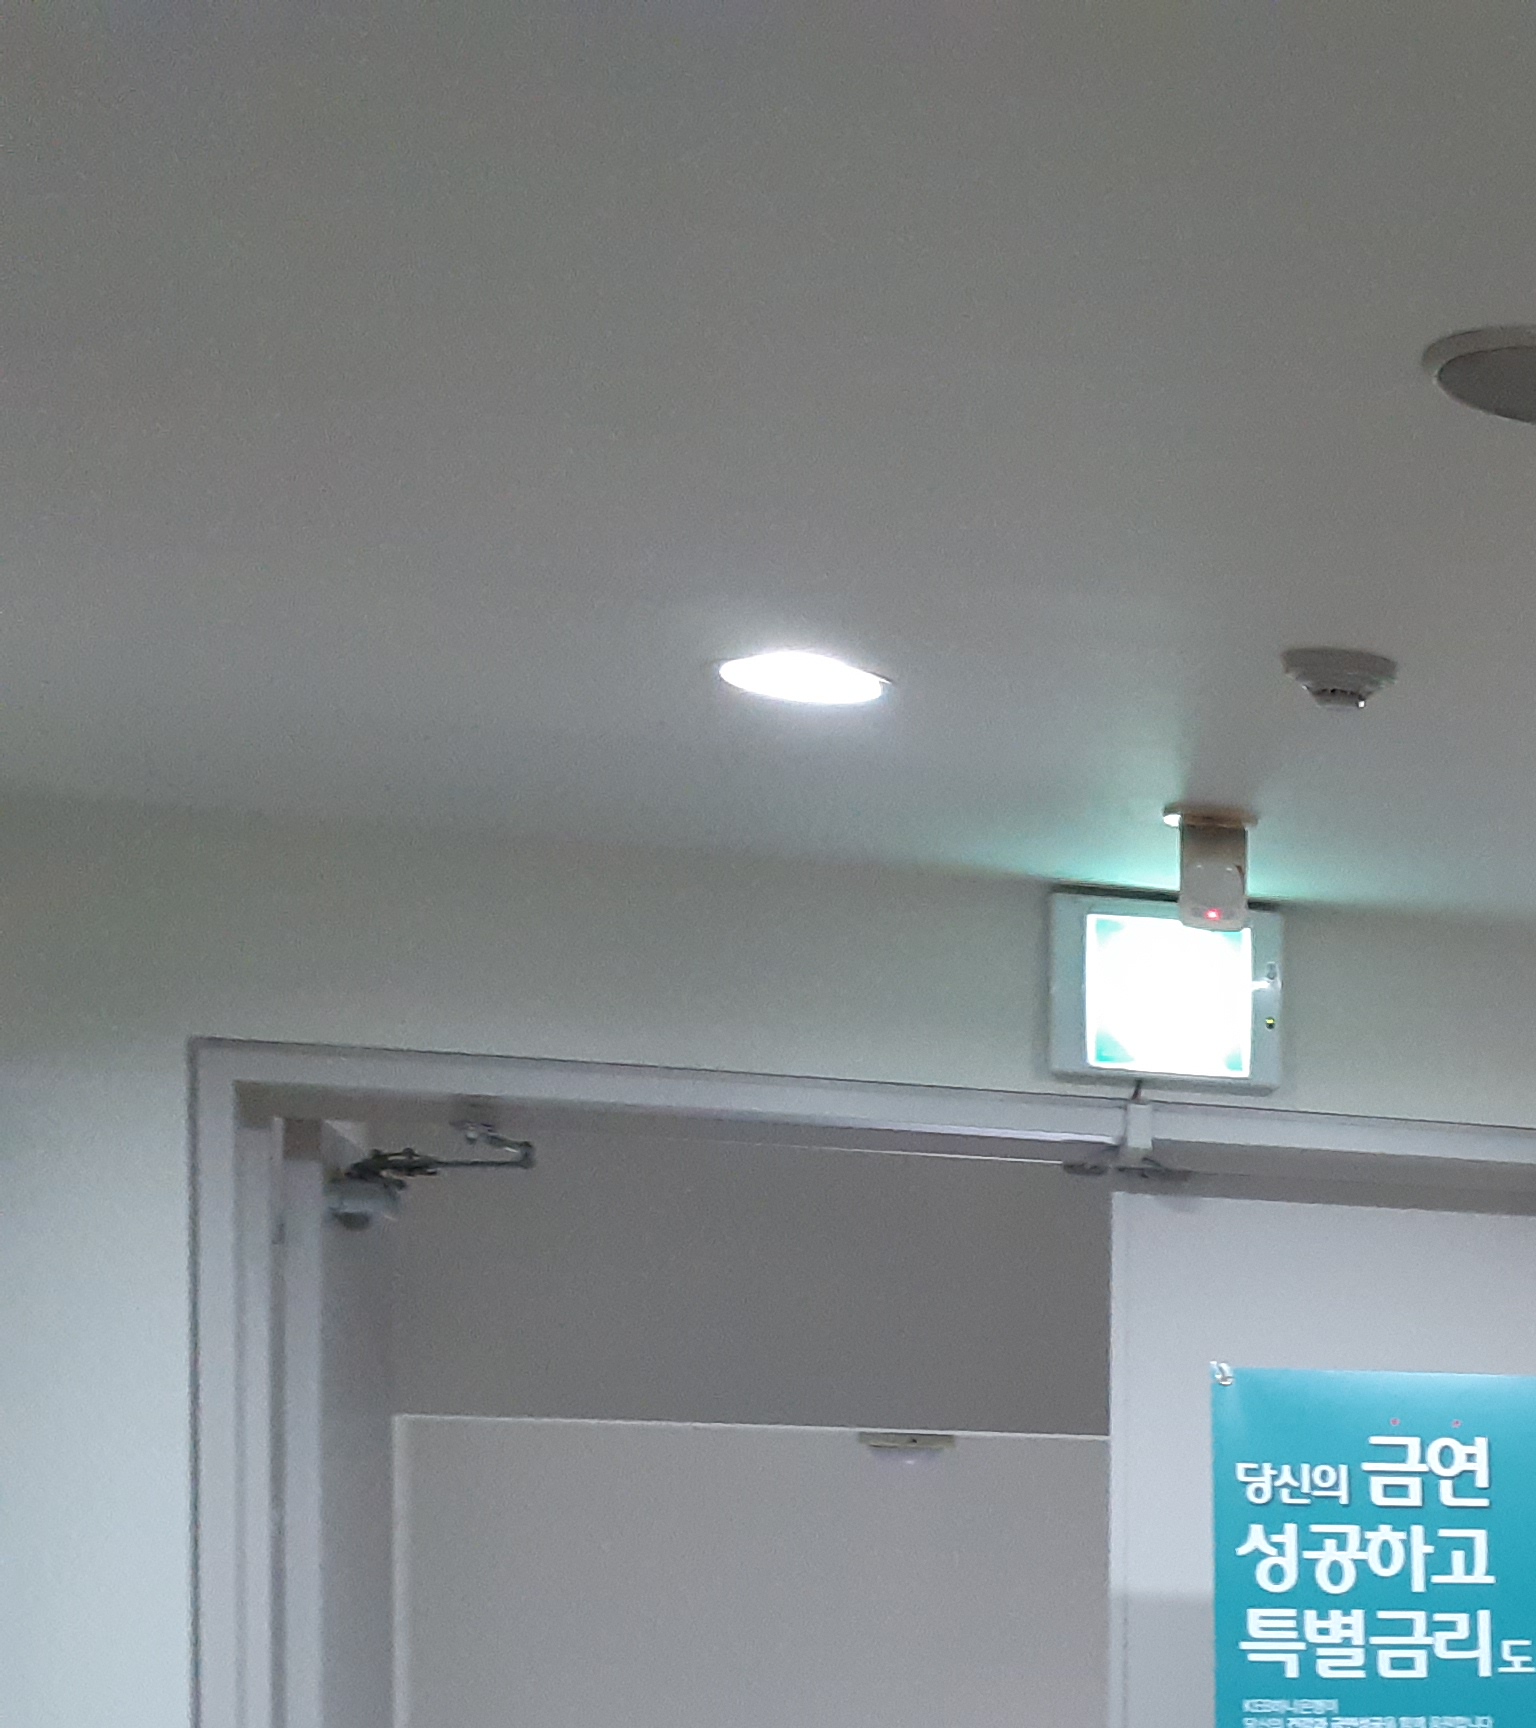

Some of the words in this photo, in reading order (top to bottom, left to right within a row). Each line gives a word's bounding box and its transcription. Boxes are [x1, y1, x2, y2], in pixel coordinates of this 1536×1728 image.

[1235, 1462, 1350, 1505] 당신의
[1362, 1435, 1490, 1508] 금연
[1236, 1522, 1496, 1594] 성공하고
[1239, 1606, 1536, 1679] 특별금리도
